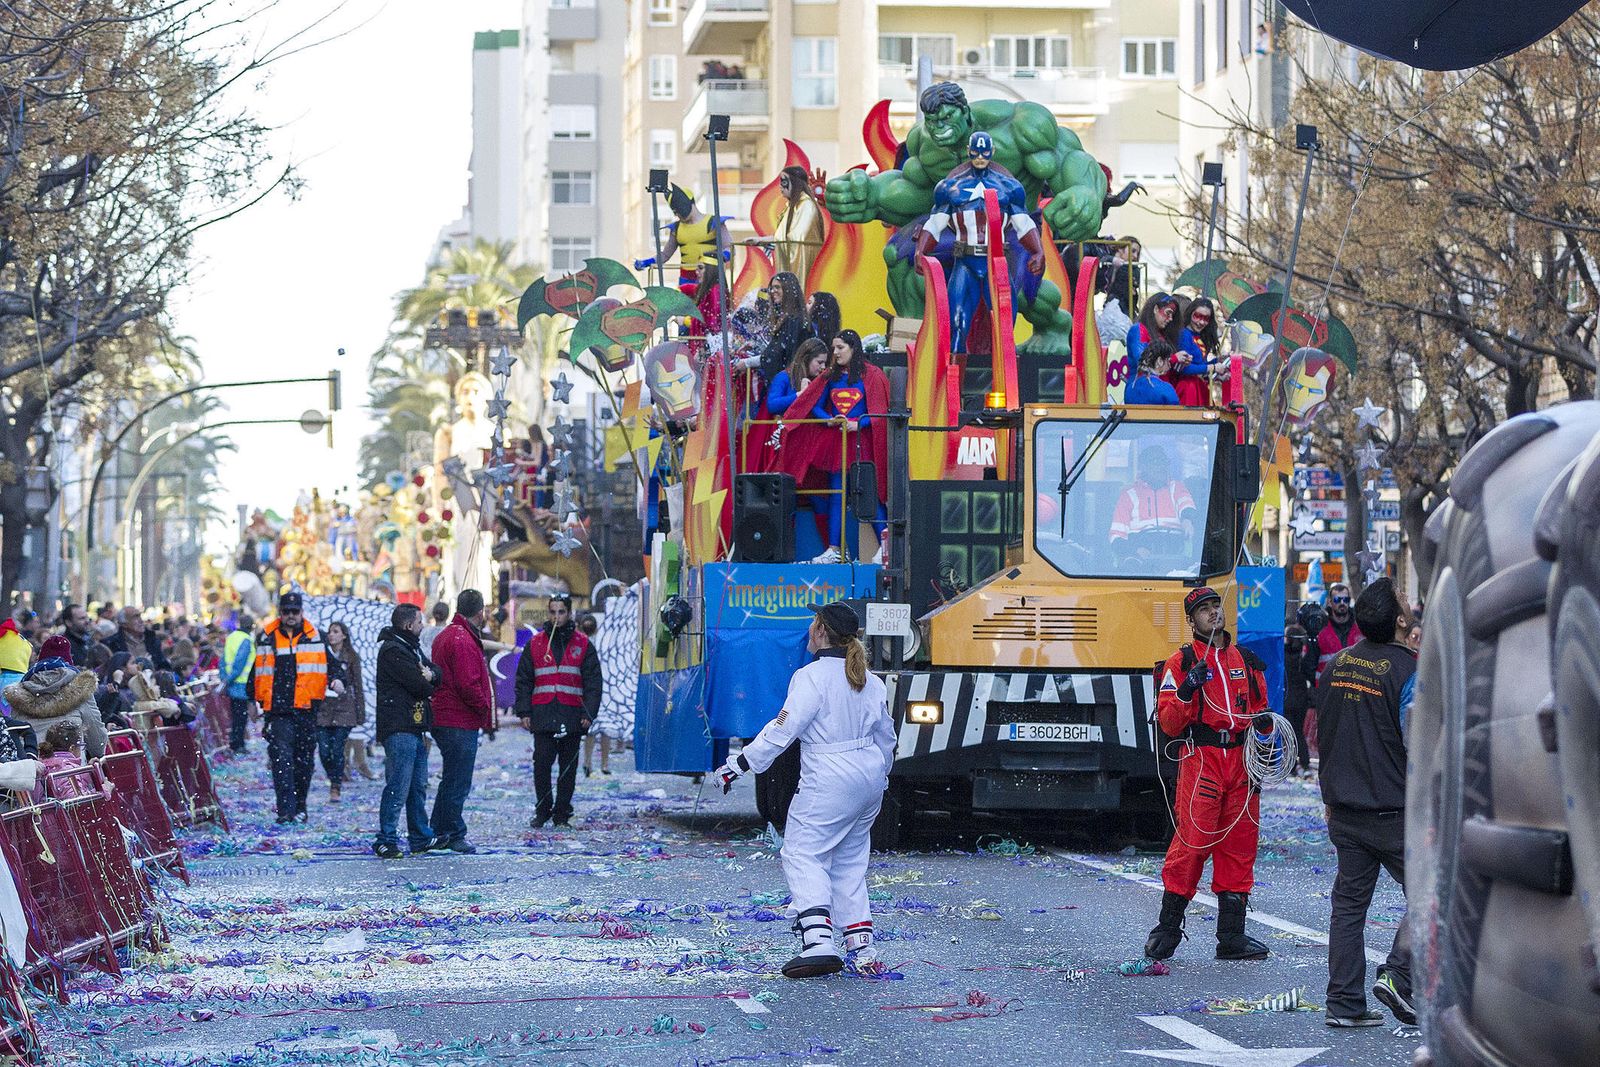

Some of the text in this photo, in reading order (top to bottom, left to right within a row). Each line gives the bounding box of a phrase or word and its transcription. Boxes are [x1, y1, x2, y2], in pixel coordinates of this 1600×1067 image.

[868, 608, 909, 619] E 3602
[877, 619, 899, 631] BGH
[1017, 725, 1026, 739] E
